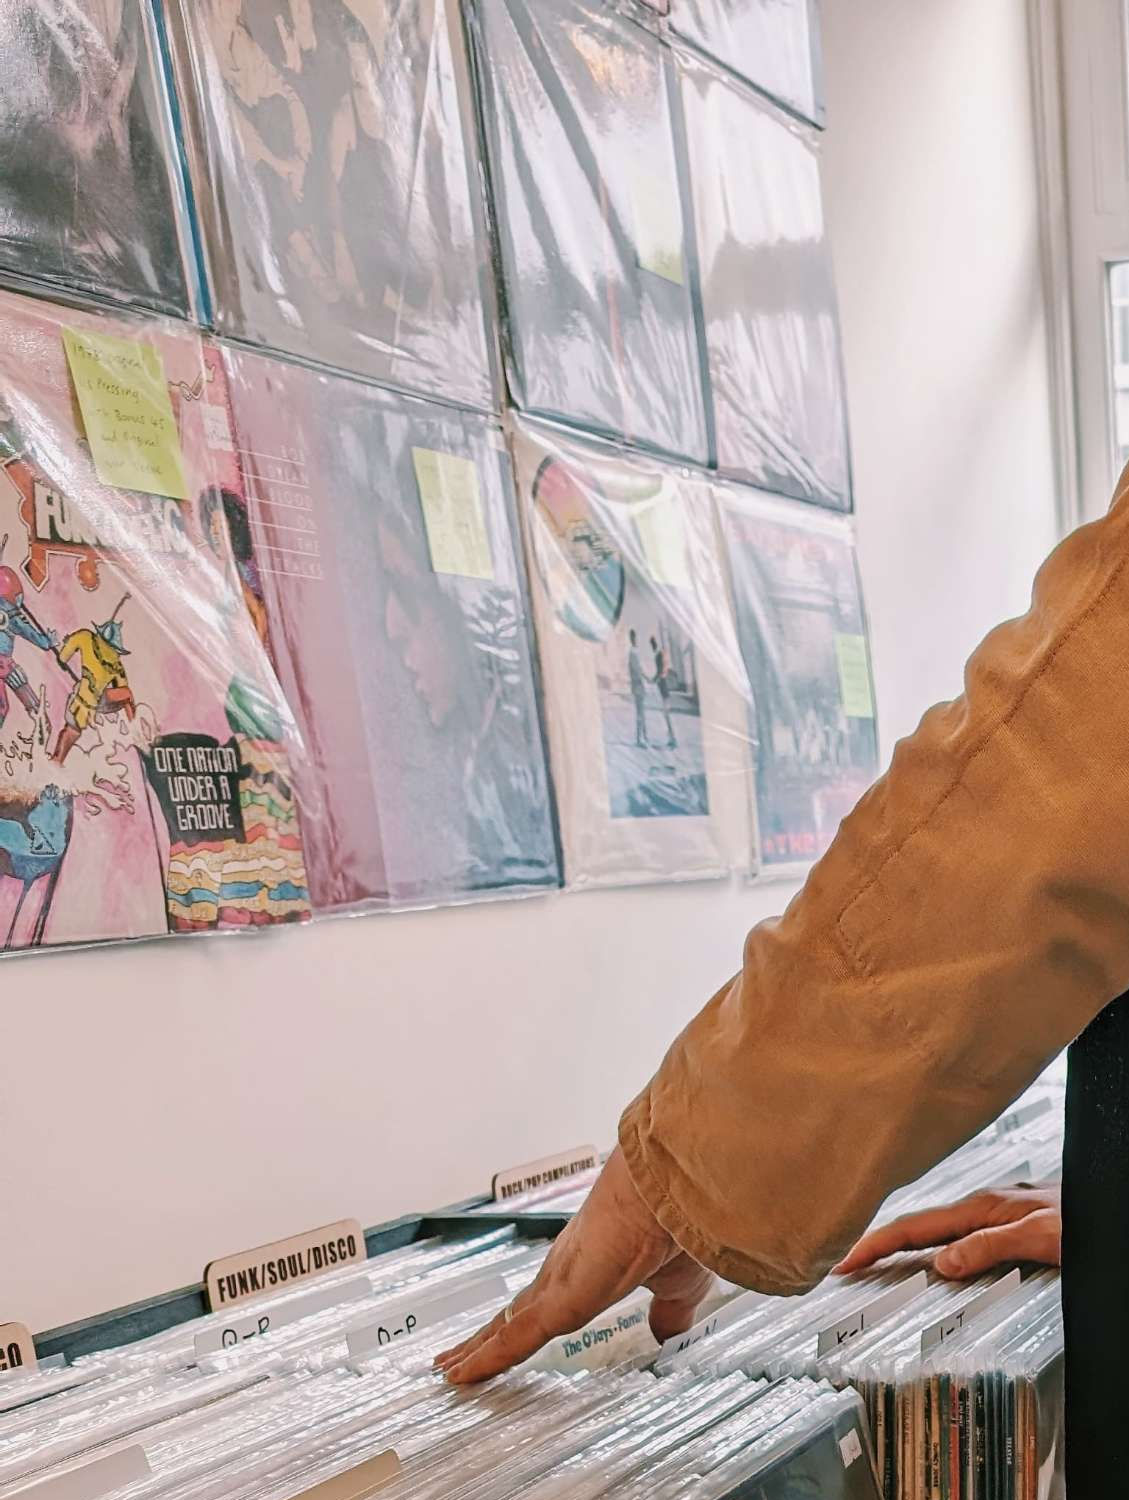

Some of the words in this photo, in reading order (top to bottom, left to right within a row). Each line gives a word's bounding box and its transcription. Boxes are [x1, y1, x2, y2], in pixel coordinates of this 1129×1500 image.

[154, 747, 187, 773] ONE
[188, 747, 239, 773] NATION
[168, 775, 217, 802] UNDER
[219, 775, 232, 801] A
[176, 803, 235, 831] GROOVE
[217, 1234, 357, 1303] FUNK/SOUL/DISCO
[562, 1339, 582, 1358] The
